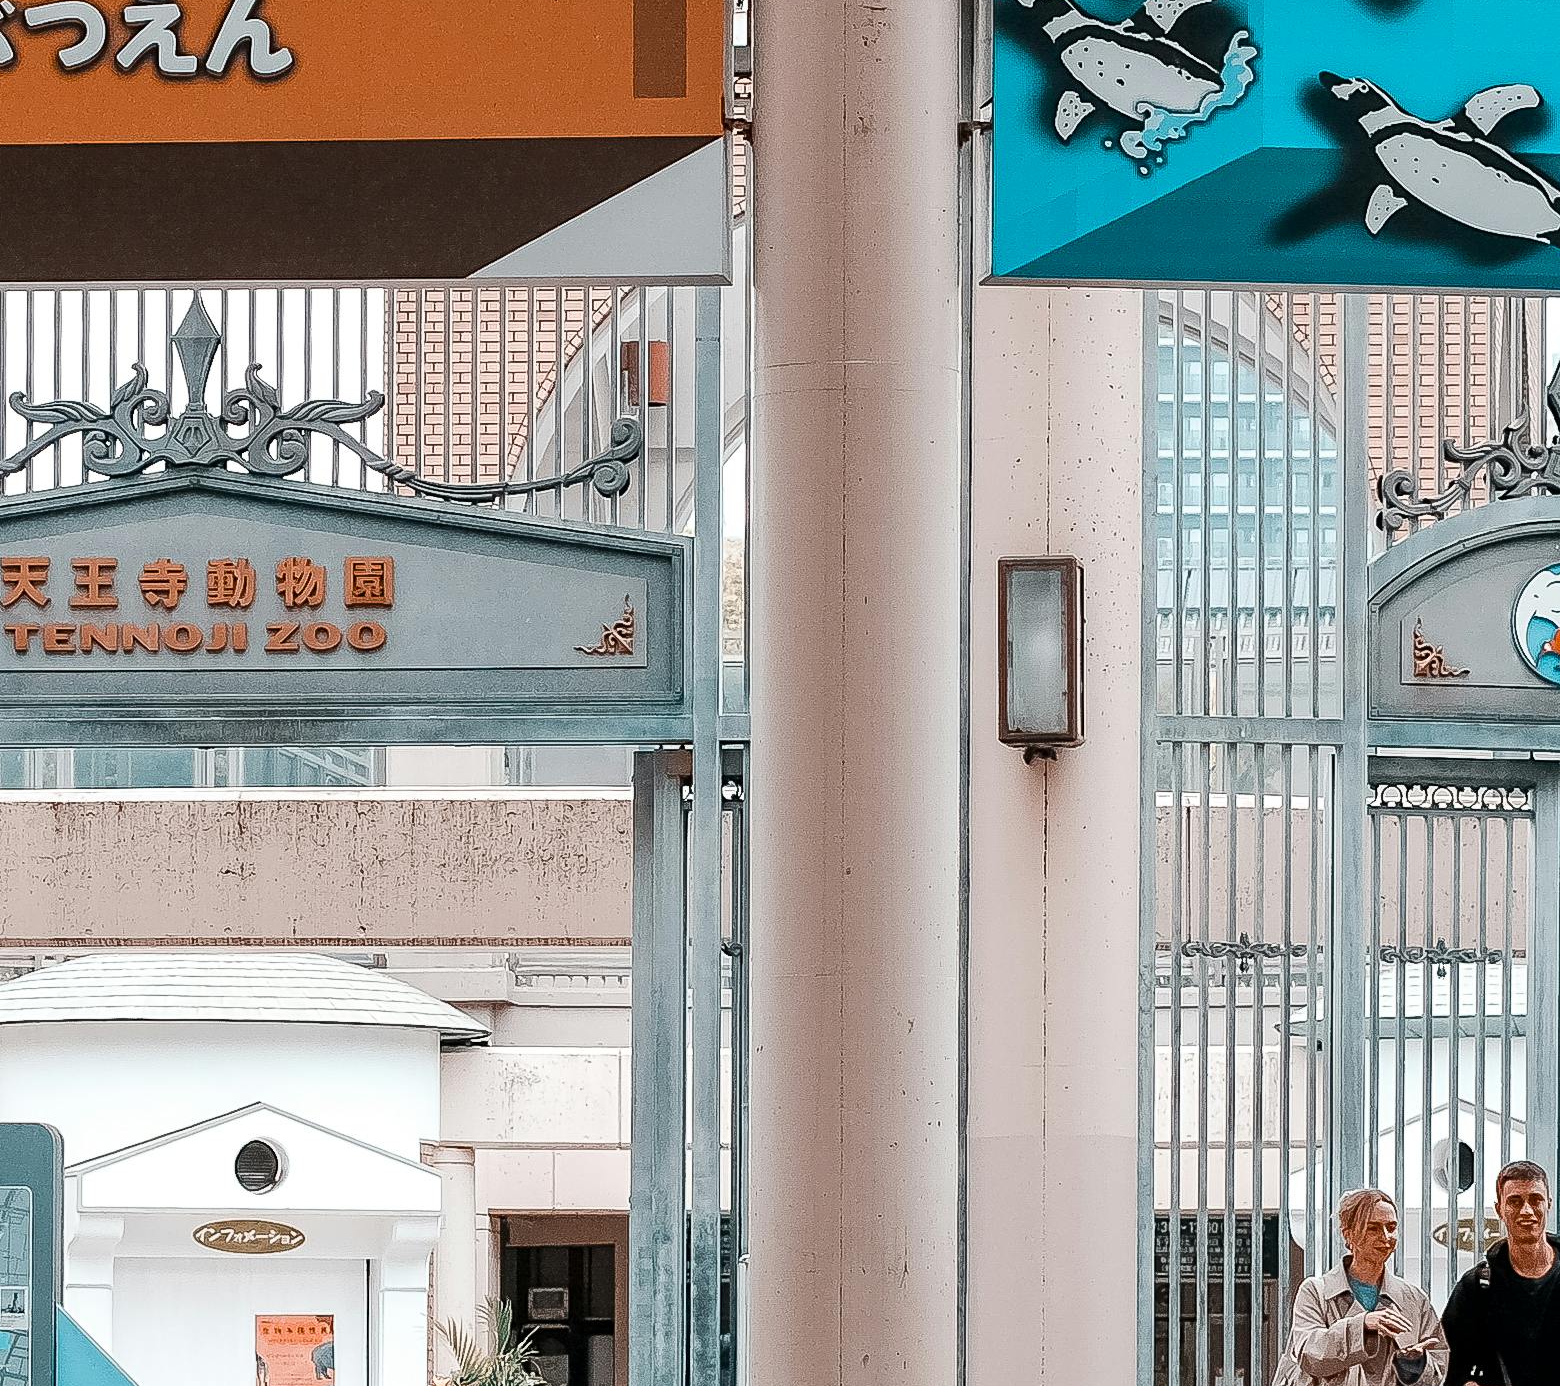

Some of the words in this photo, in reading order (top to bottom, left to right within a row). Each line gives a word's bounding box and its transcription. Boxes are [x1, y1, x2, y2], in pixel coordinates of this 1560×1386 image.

[0, 554, 396, 611] 天王寺動物園
[5, 621, 247, 655] TENNOJI
[265, 621, 386, 654] ZOO
